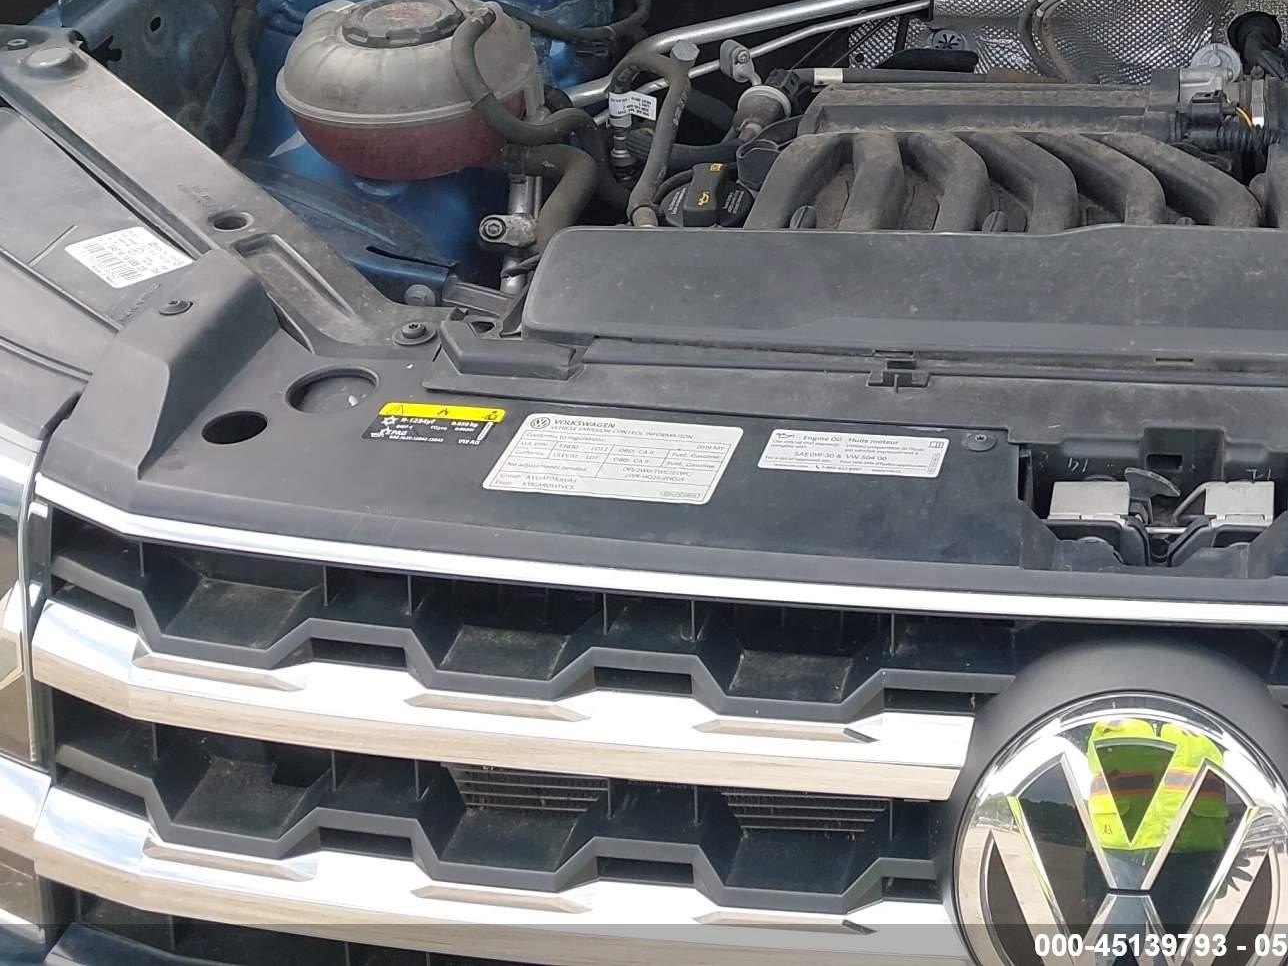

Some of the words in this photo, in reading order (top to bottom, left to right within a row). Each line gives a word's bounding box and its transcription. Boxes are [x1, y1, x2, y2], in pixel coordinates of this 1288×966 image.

[554, 419, 616, 429] VOLKSWAGEN
[645, 431, 694, 440] INFORMATION
[802, 434, 830, 442] Engine
